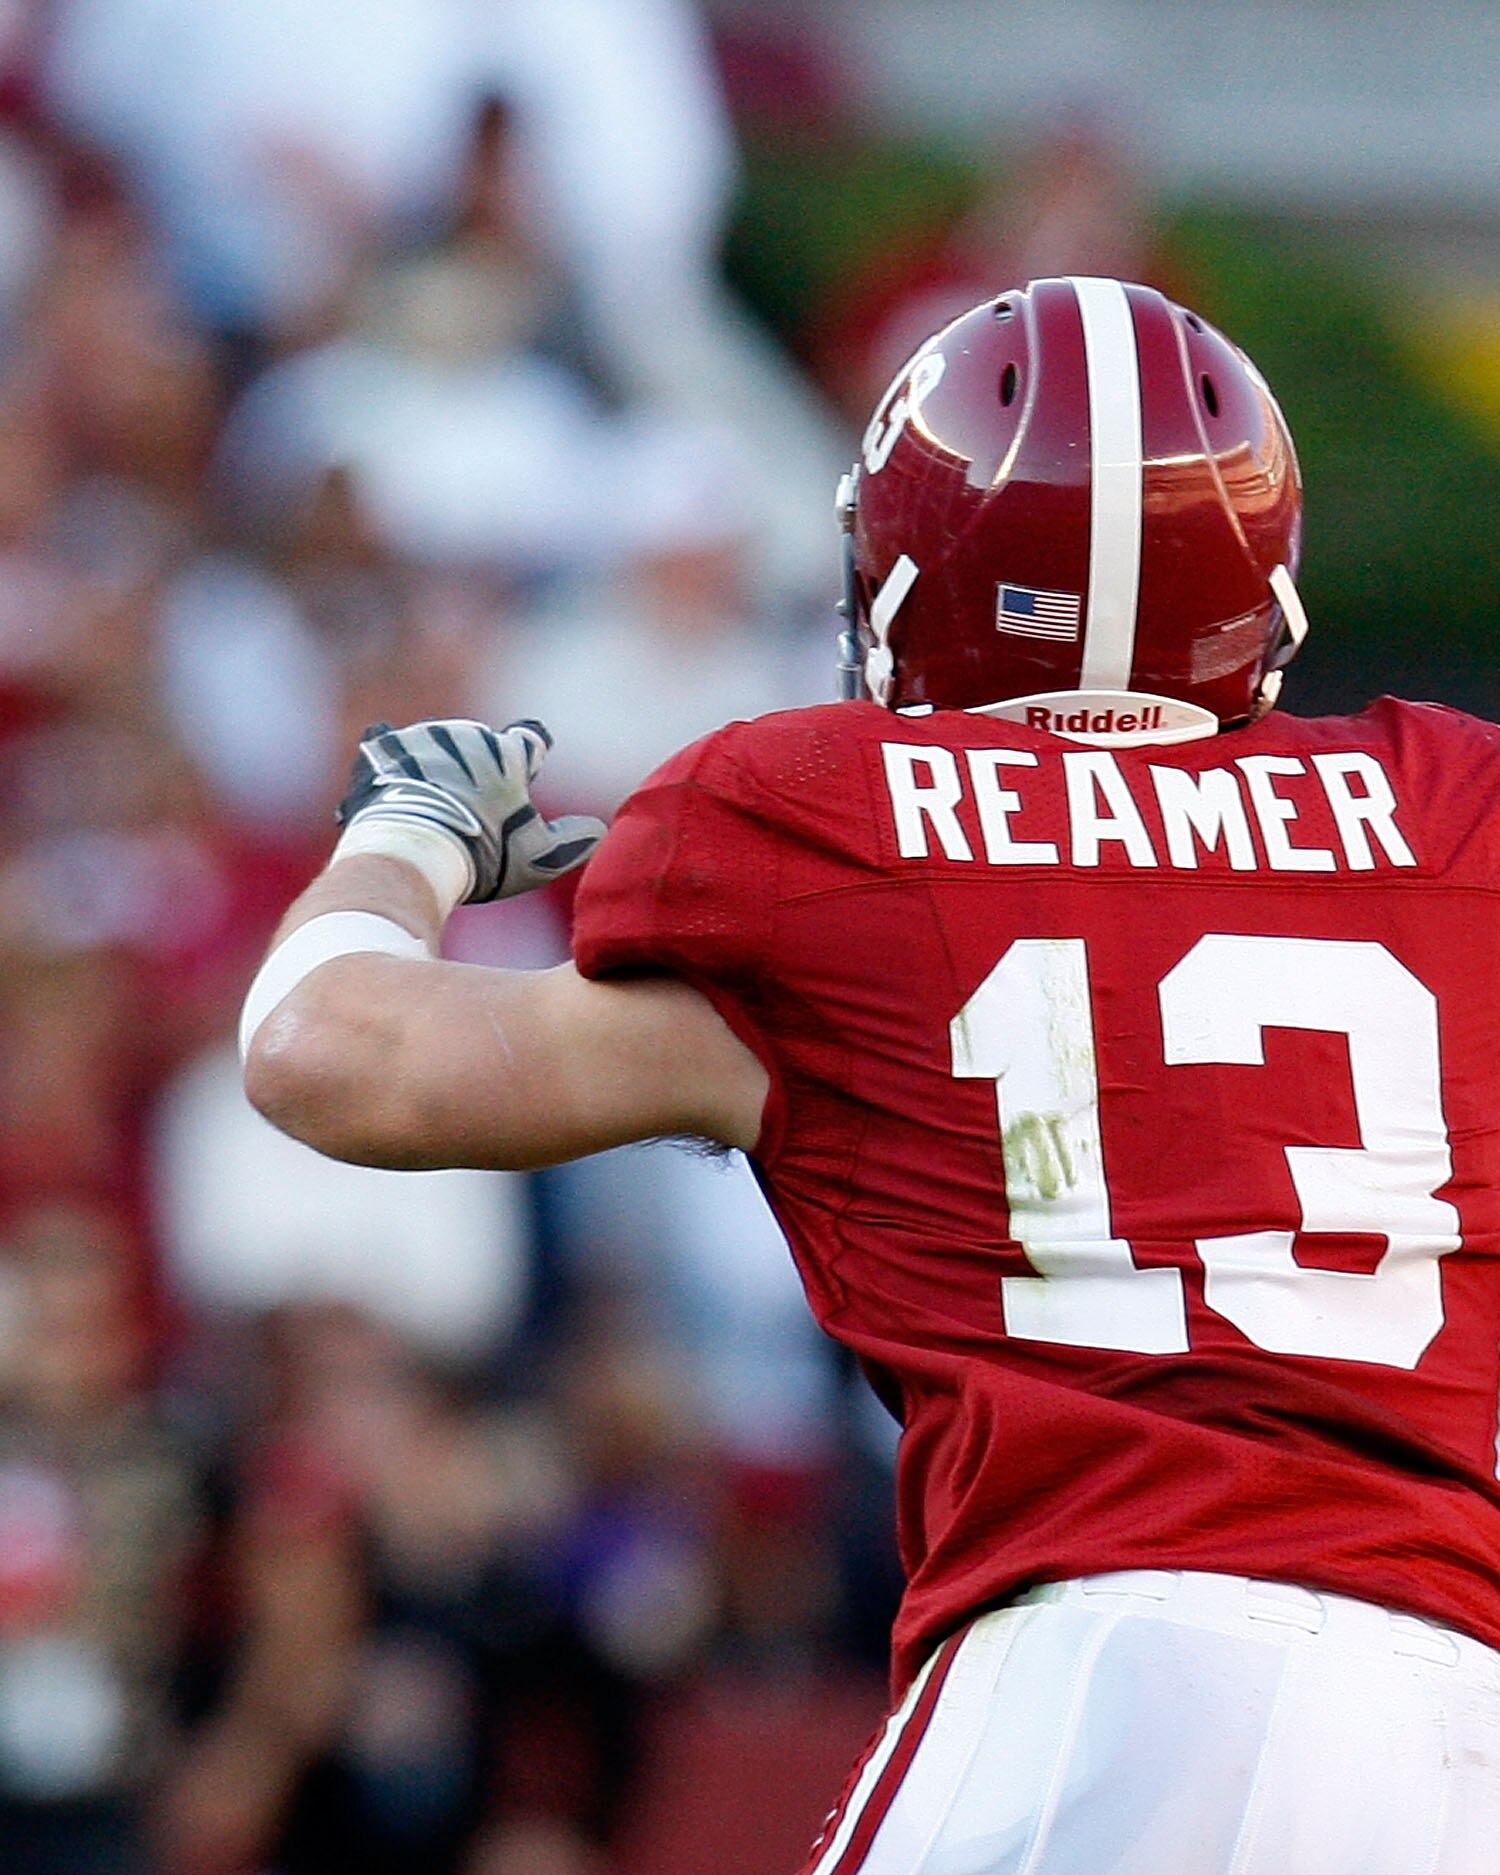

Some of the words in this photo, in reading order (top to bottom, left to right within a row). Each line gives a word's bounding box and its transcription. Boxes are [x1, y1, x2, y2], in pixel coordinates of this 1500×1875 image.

[1025, 705, 1164, 735] Riddell
[881, 741, 1418, 872] REAMER
[949, 933, 1463, 1371] 13
